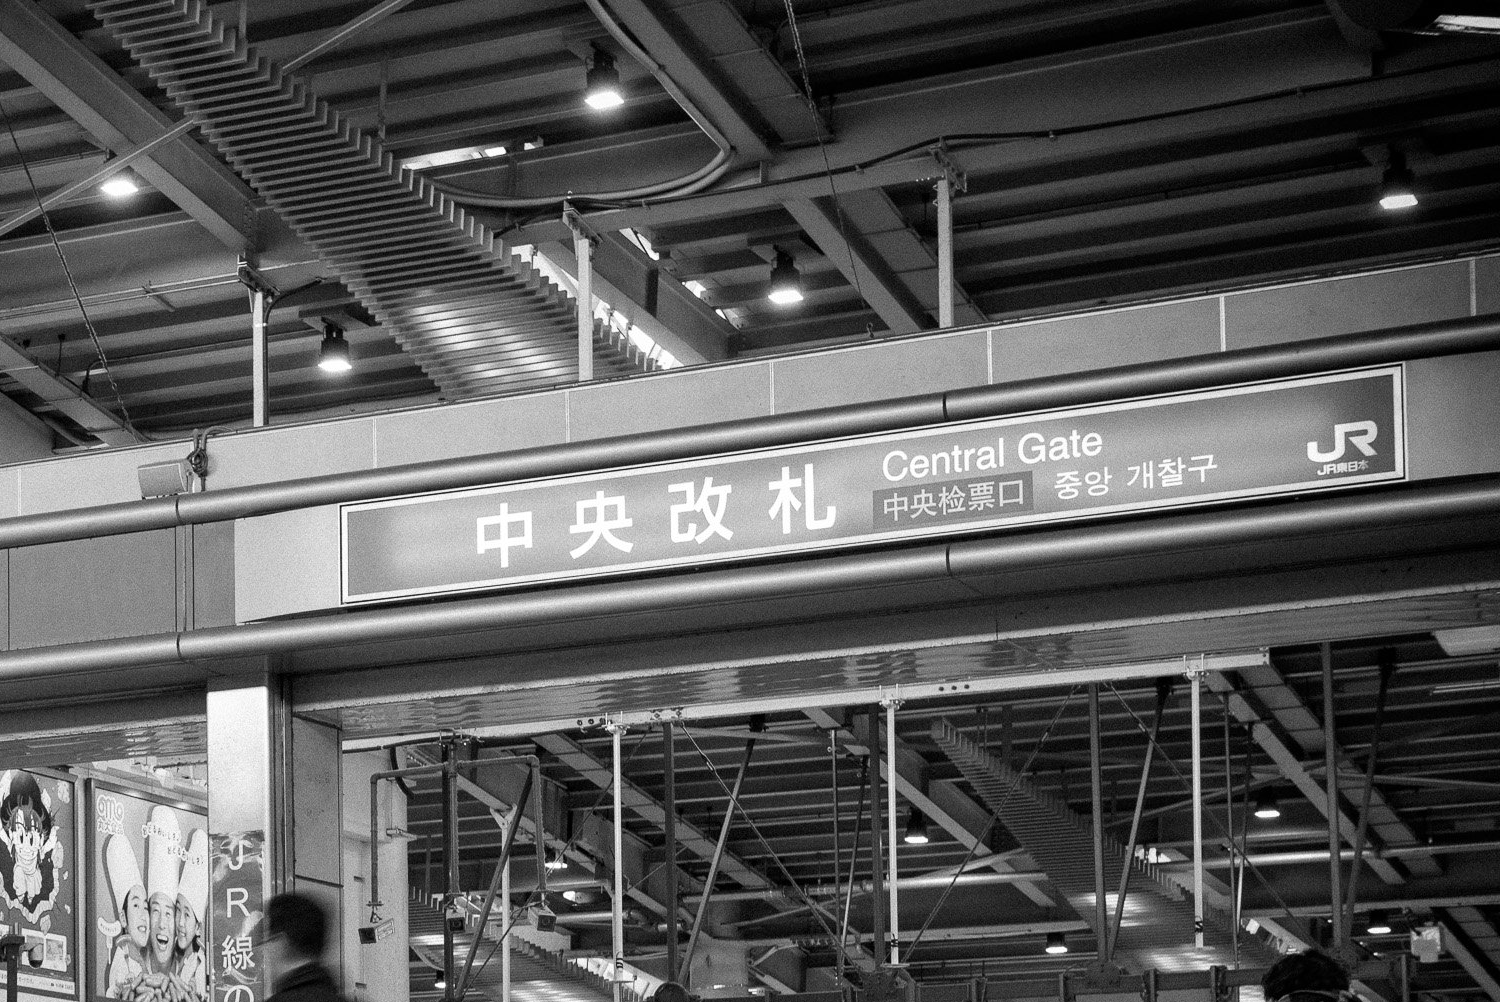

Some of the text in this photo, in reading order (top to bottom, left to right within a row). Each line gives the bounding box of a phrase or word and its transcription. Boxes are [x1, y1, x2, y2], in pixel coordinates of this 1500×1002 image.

[881, 427, 1104, 485] Central Gate
[1306, 420, 1379, 463] JR
[1052, 453, 1219, 501] 중앙 개찰구
[1317, 458, 1371, 477] JR東日本
[475, 463, 838, 569] 中央改札
[882, 478, 1026, 523] 中央检票口
